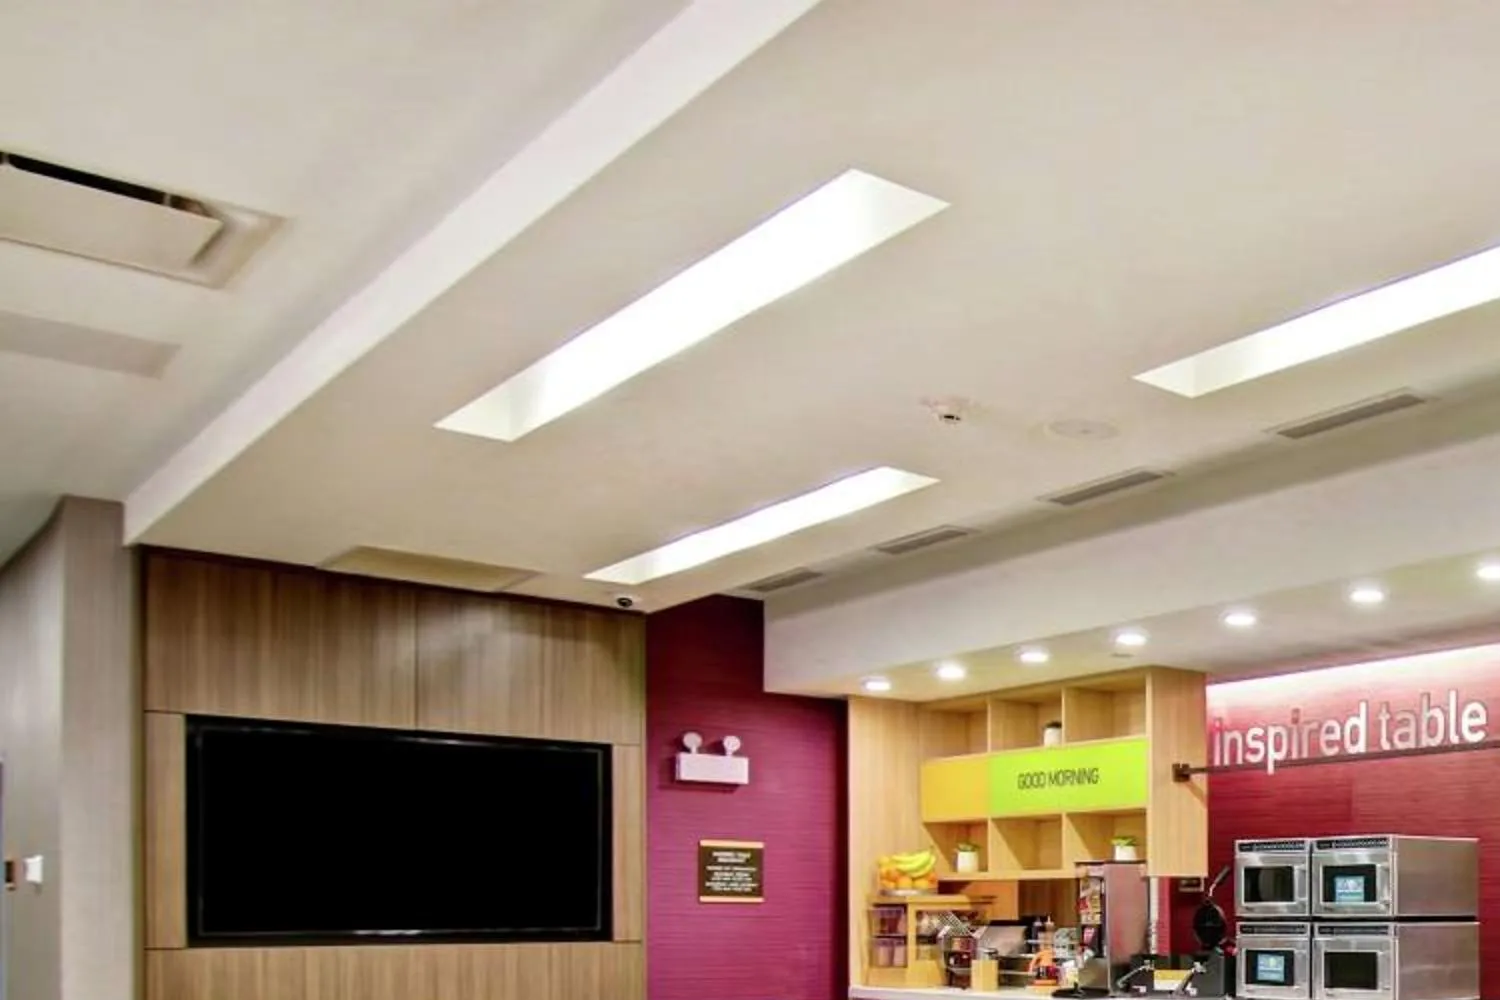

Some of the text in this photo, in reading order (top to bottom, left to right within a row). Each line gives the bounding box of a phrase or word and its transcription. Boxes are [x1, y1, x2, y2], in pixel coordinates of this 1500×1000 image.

[1214, 689, 1488, 774] inspired table
[1018, 768, 1100, 789] GOOD MORNING
